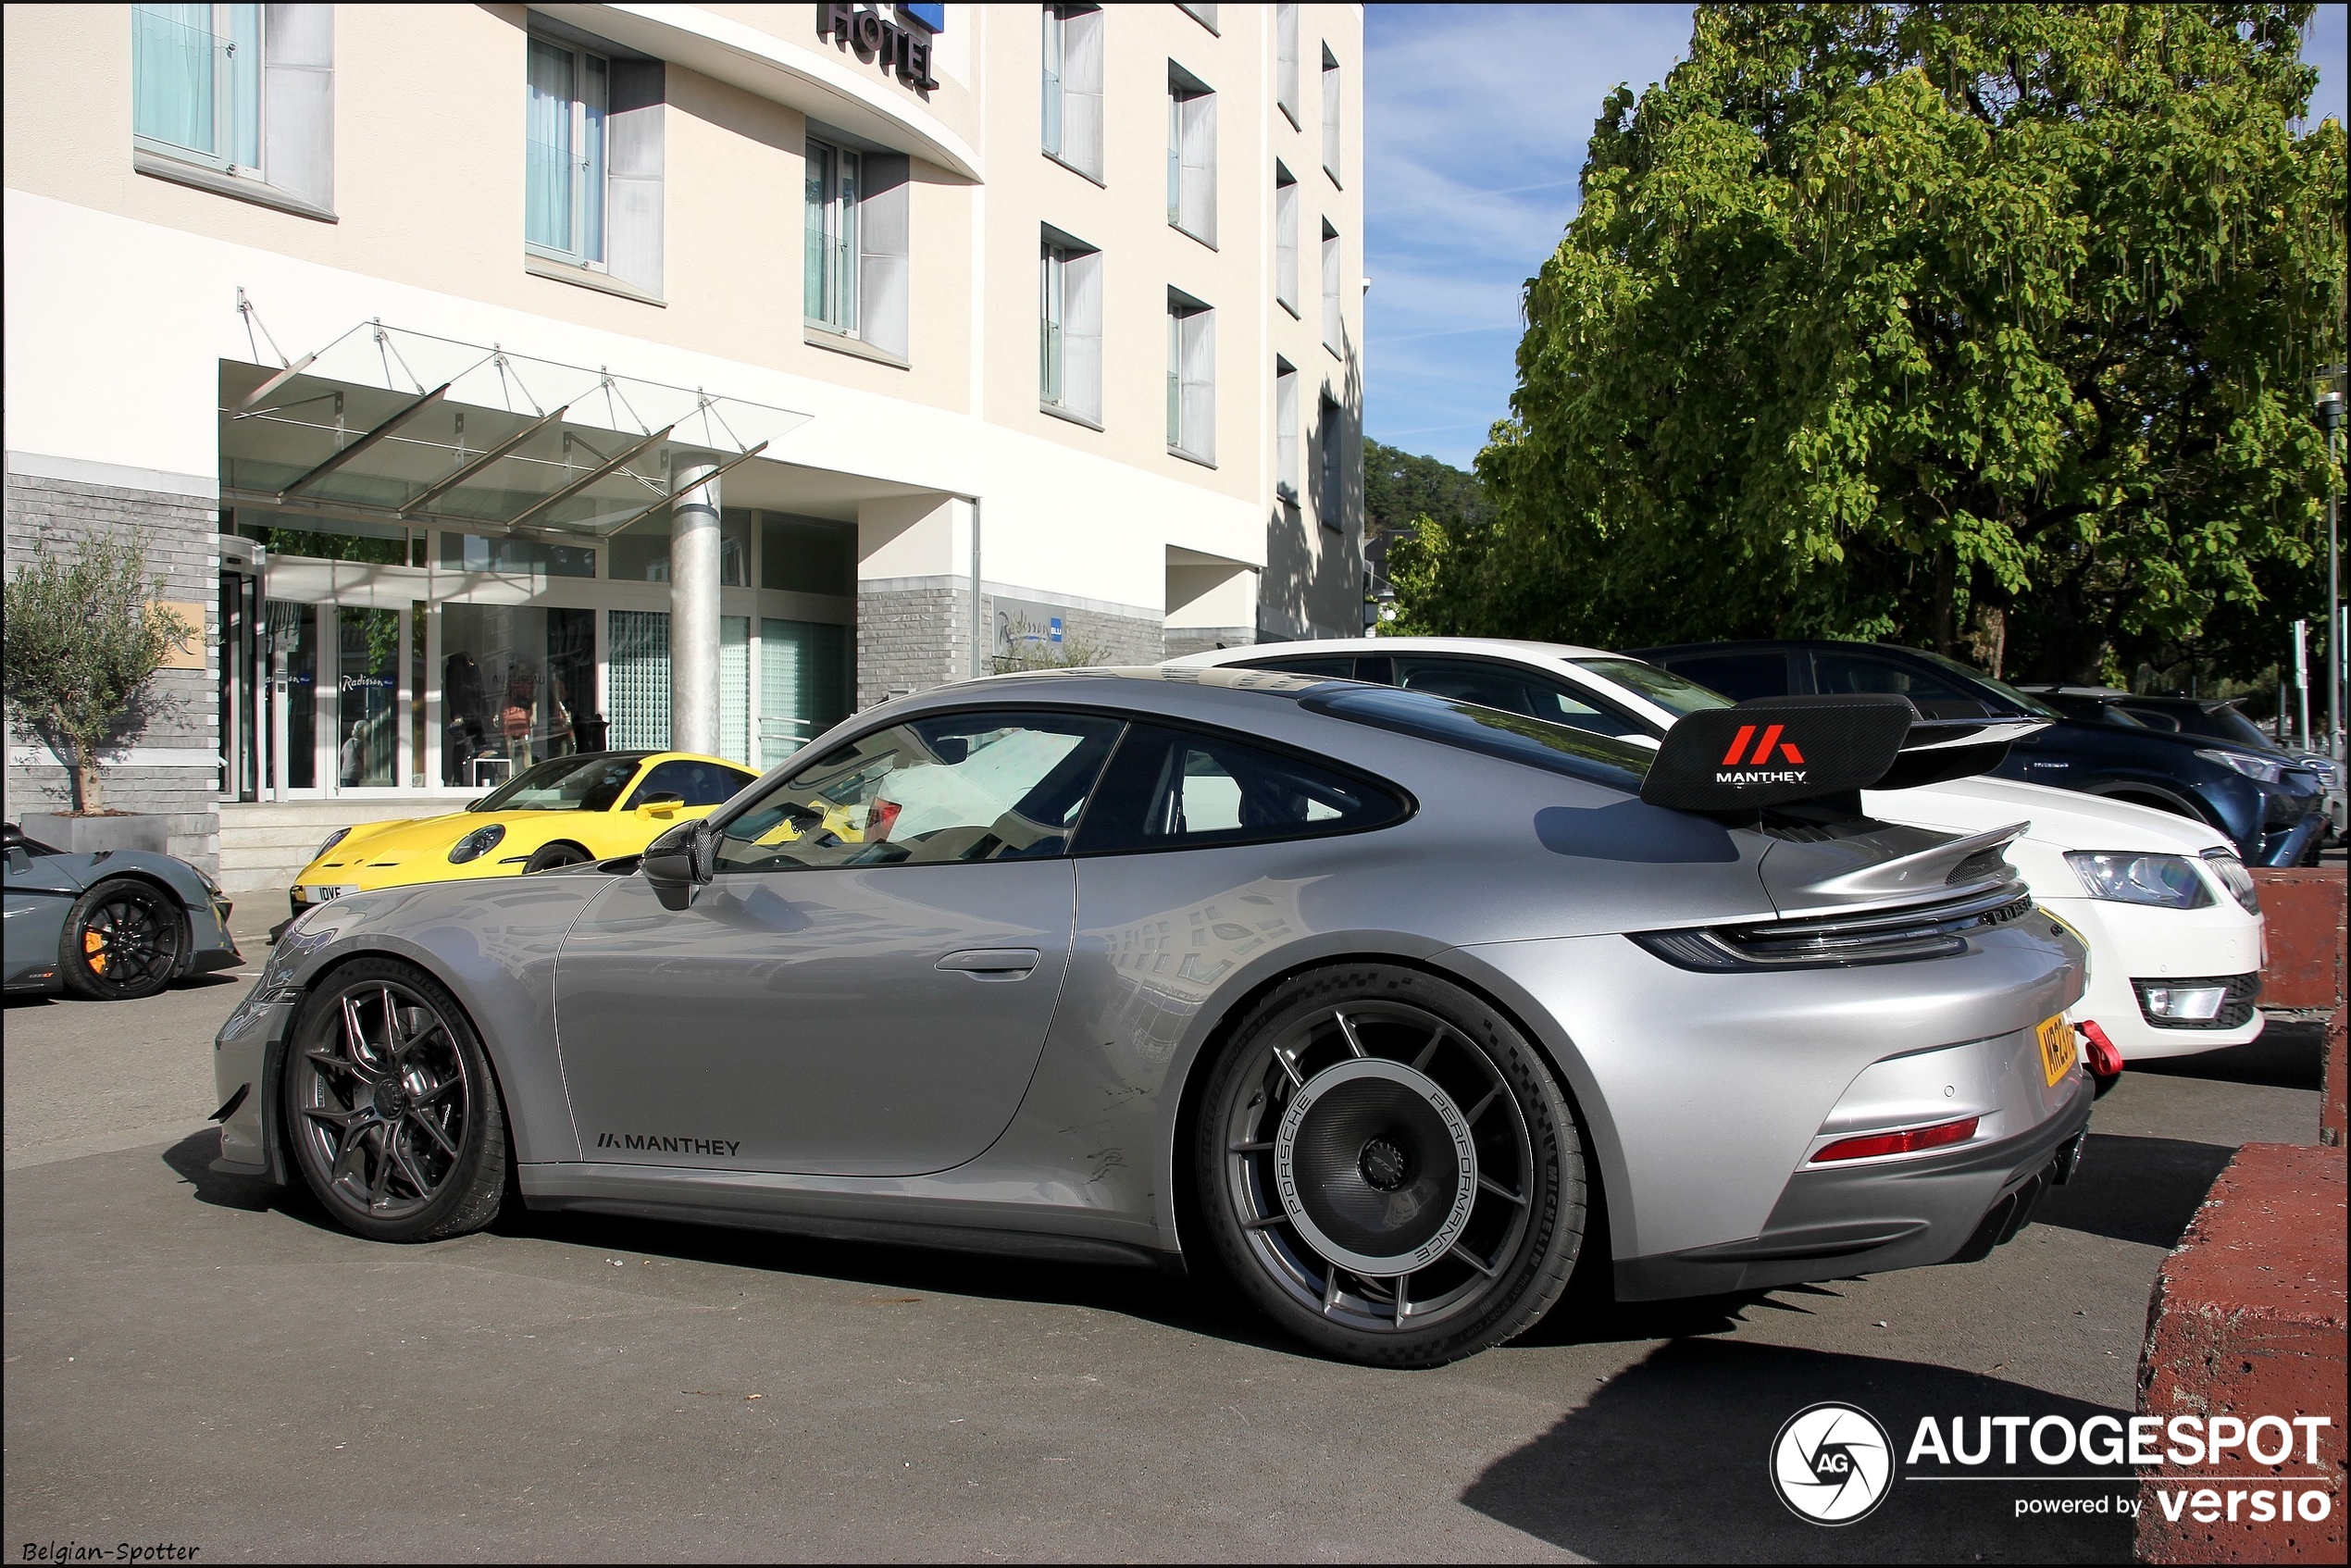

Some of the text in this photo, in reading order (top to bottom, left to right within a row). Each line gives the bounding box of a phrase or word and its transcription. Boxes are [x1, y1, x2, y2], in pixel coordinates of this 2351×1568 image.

[816, 4, 939, 91] HOTEL
[998, 609, 1063, 645] Rdisson BLU
[342, 673, 384, 692] Radisson
[1715, 771, 1807, 783] MANTHEY
[625, 1134, 740, 1157] MANTHEY
[1277, 1093, 1312, 1215] PORSCHE
[1414, 1092, 1473, 1263] PERFORMANCE
[1528, 1164, 1559, 1268] MICHELIN
